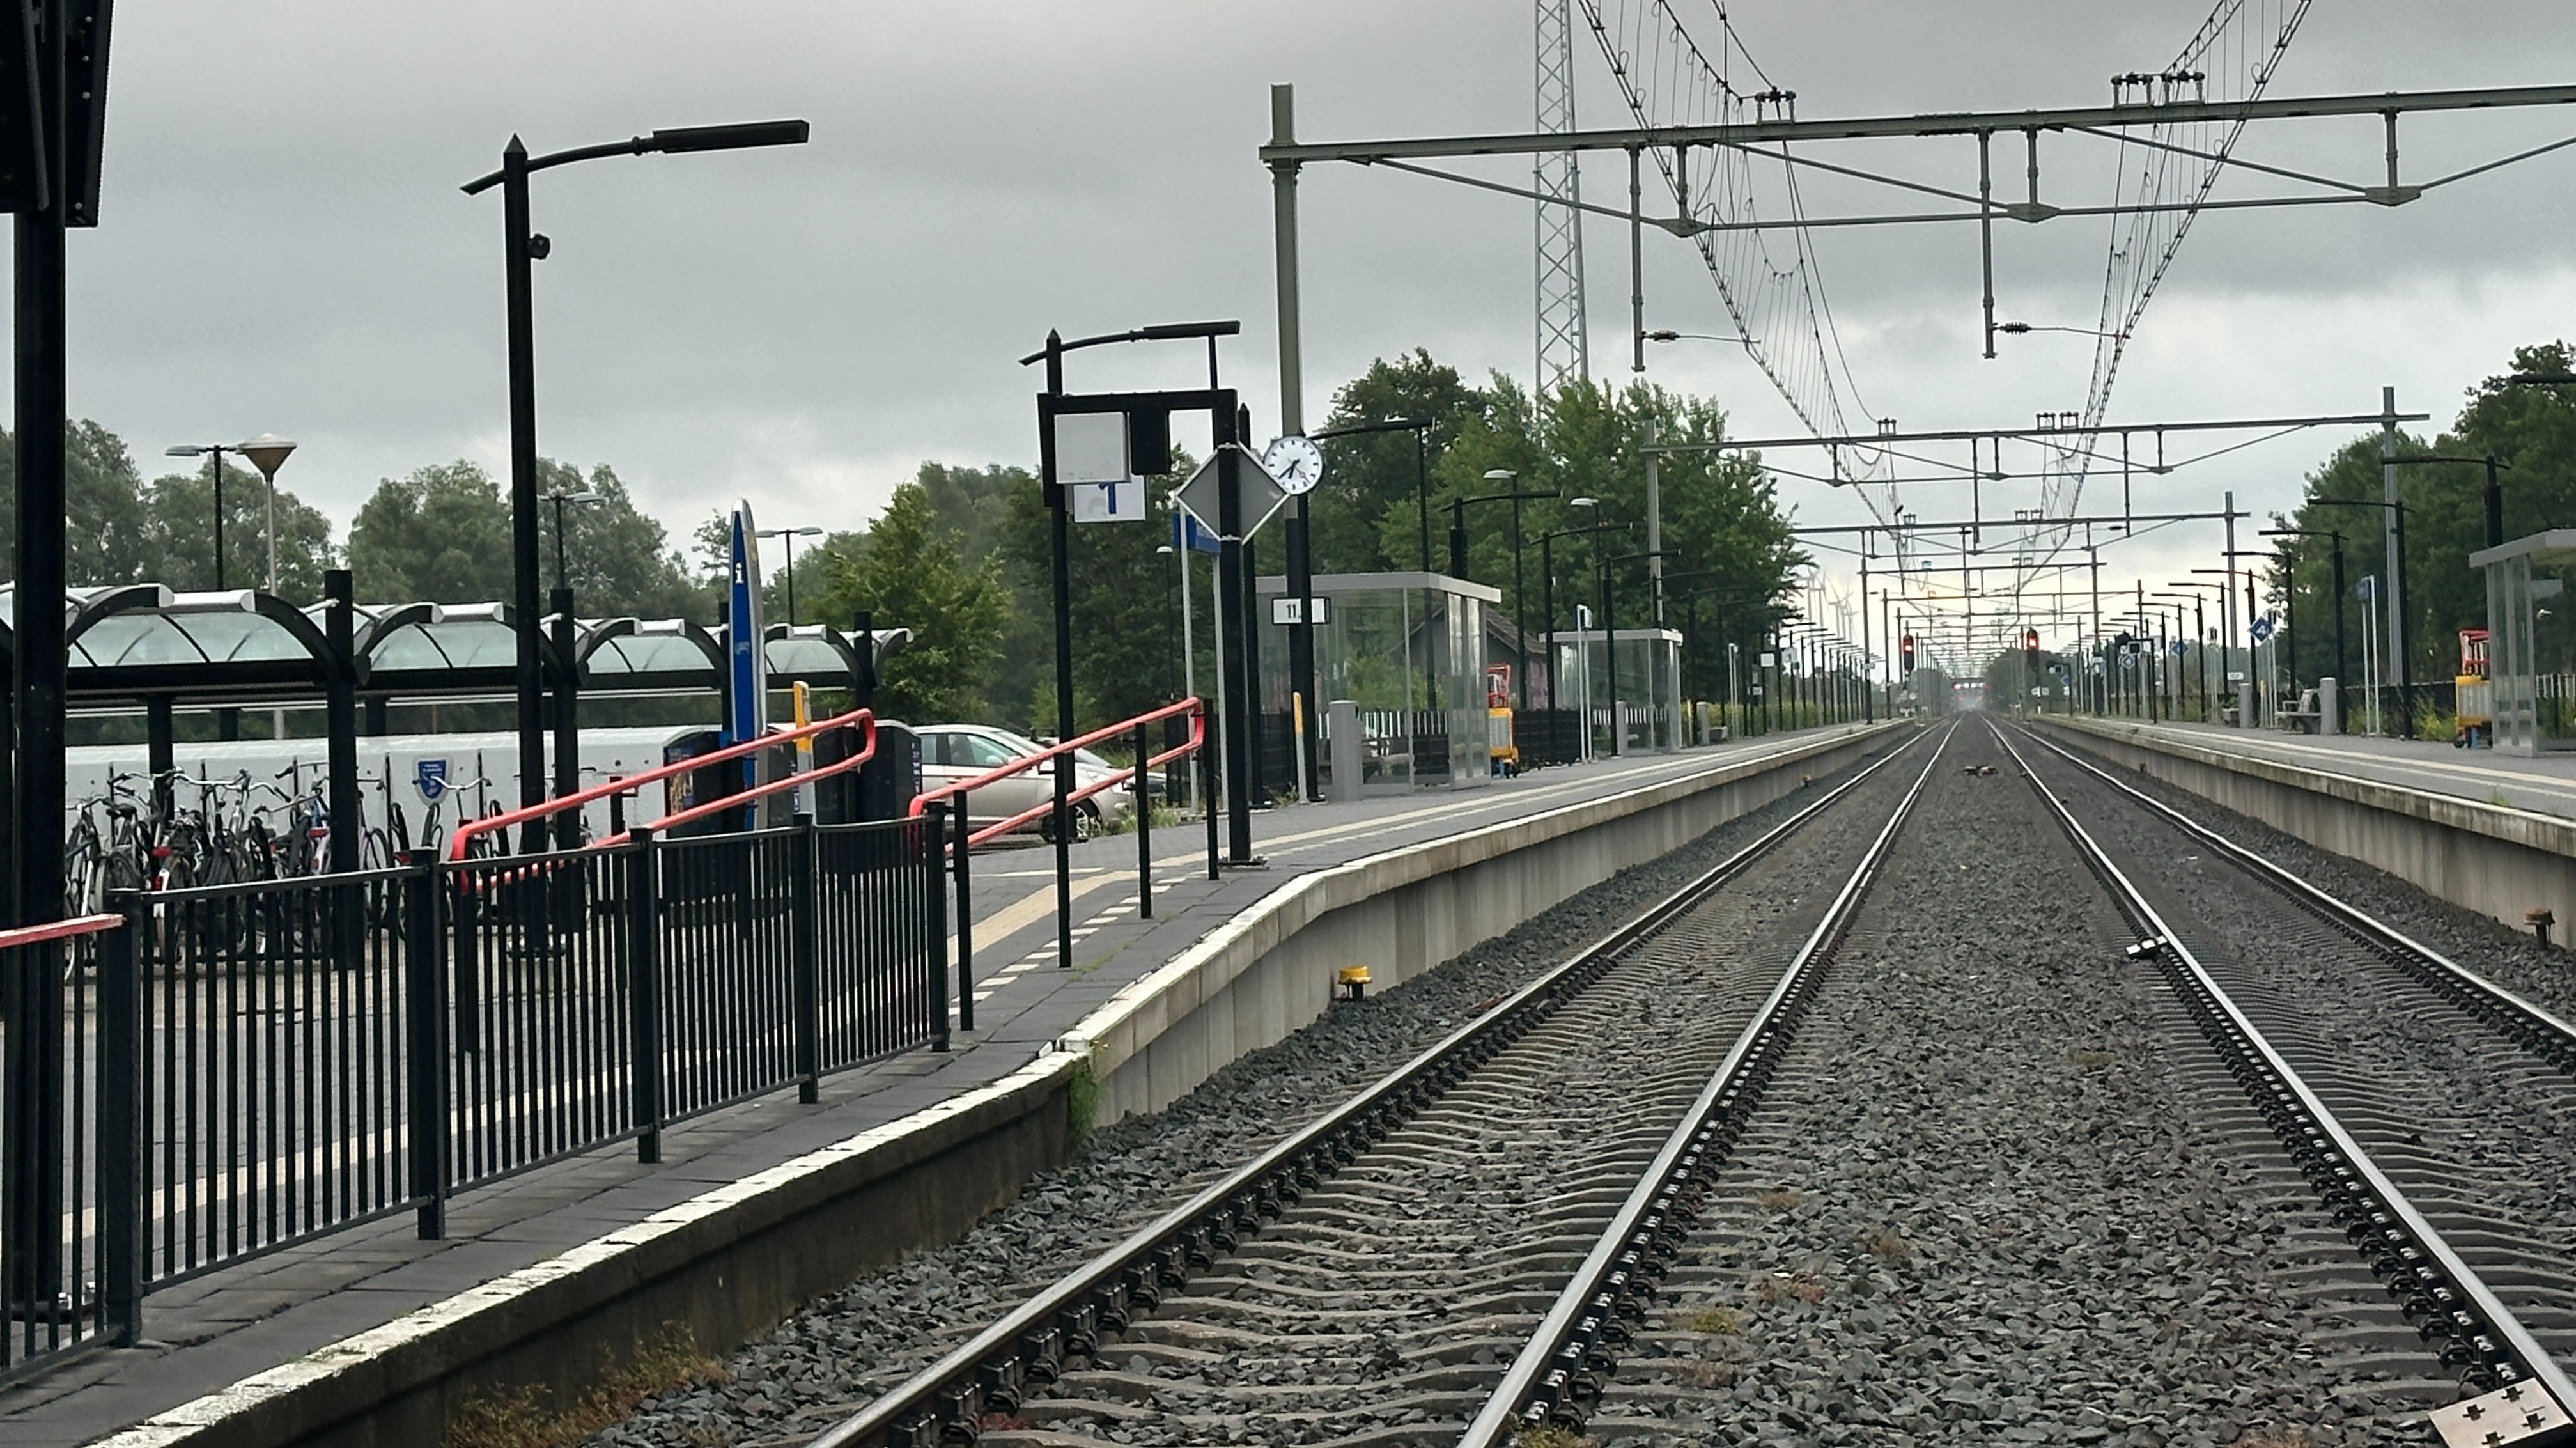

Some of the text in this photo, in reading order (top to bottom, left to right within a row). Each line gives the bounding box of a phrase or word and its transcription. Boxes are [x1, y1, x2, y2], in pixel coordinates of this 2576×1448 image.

[1099, 482, 1116, 514] 1
[1286, 603, 1296, 618] 11
[2256, 625, 2267, 635] 4
